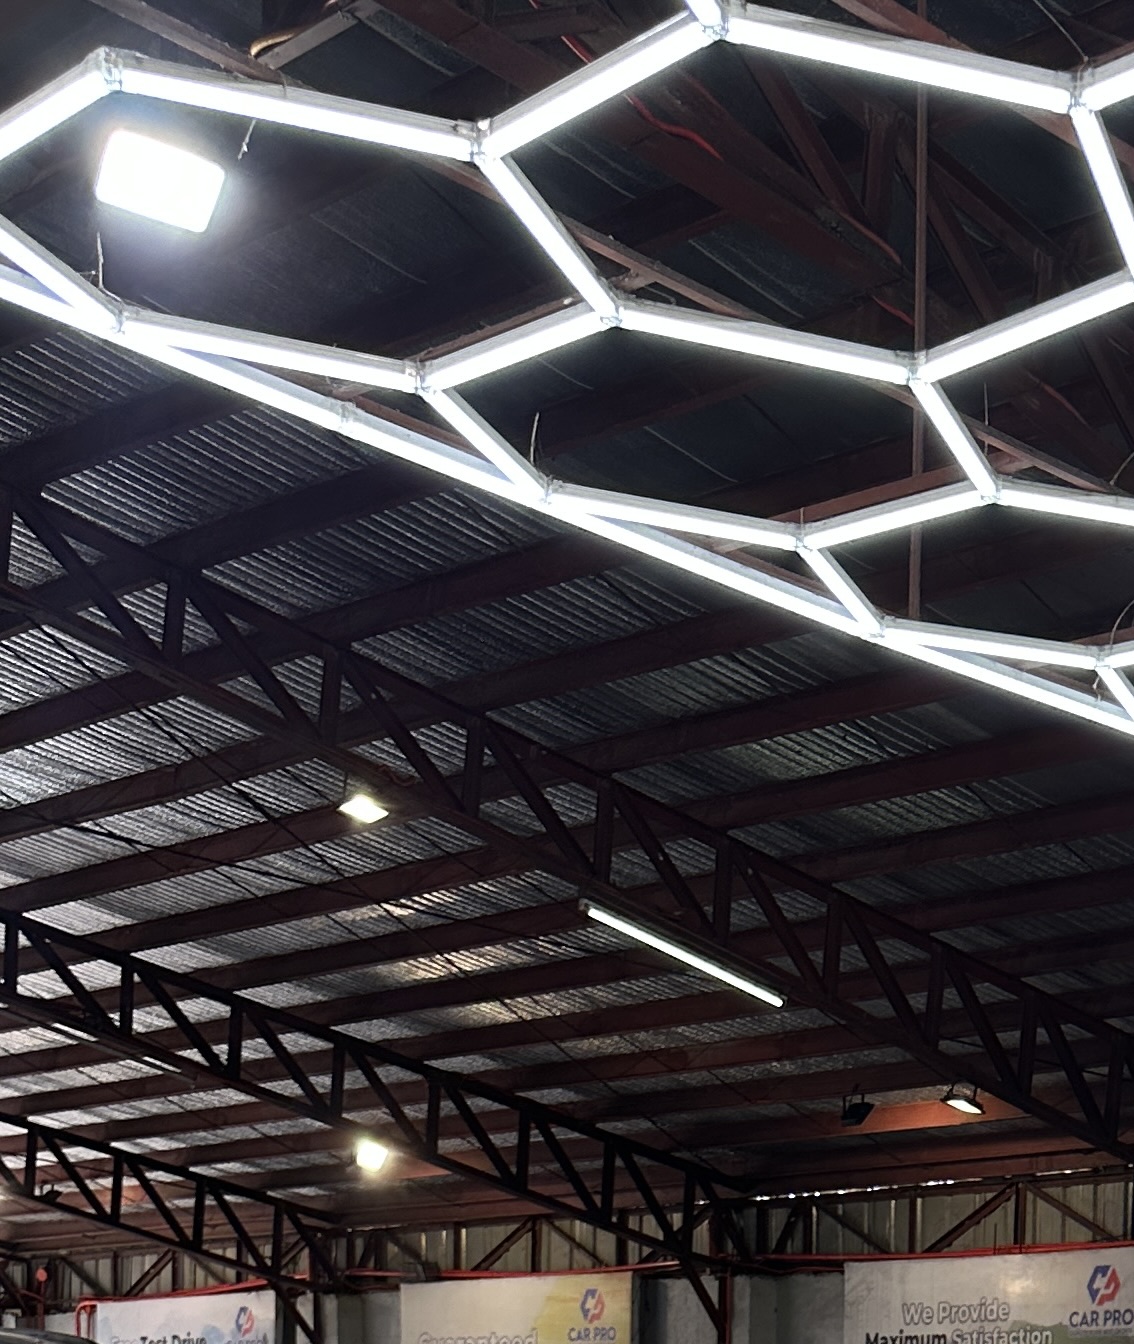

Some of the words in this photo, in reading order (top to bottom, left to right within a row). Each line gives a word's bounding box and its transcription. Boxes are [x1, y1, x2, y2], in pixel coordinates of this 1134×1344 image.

[902, 1303, 934, 1325] We
[937, 1297, 1010, 1324] Provide
[1069, 1310, 1099, 1327] CAR
[1103, 1308, 1134, 1327] PRO
[568, 1327, 590, 1341] CAR
[593, 1326, 616, 1341] PRO
